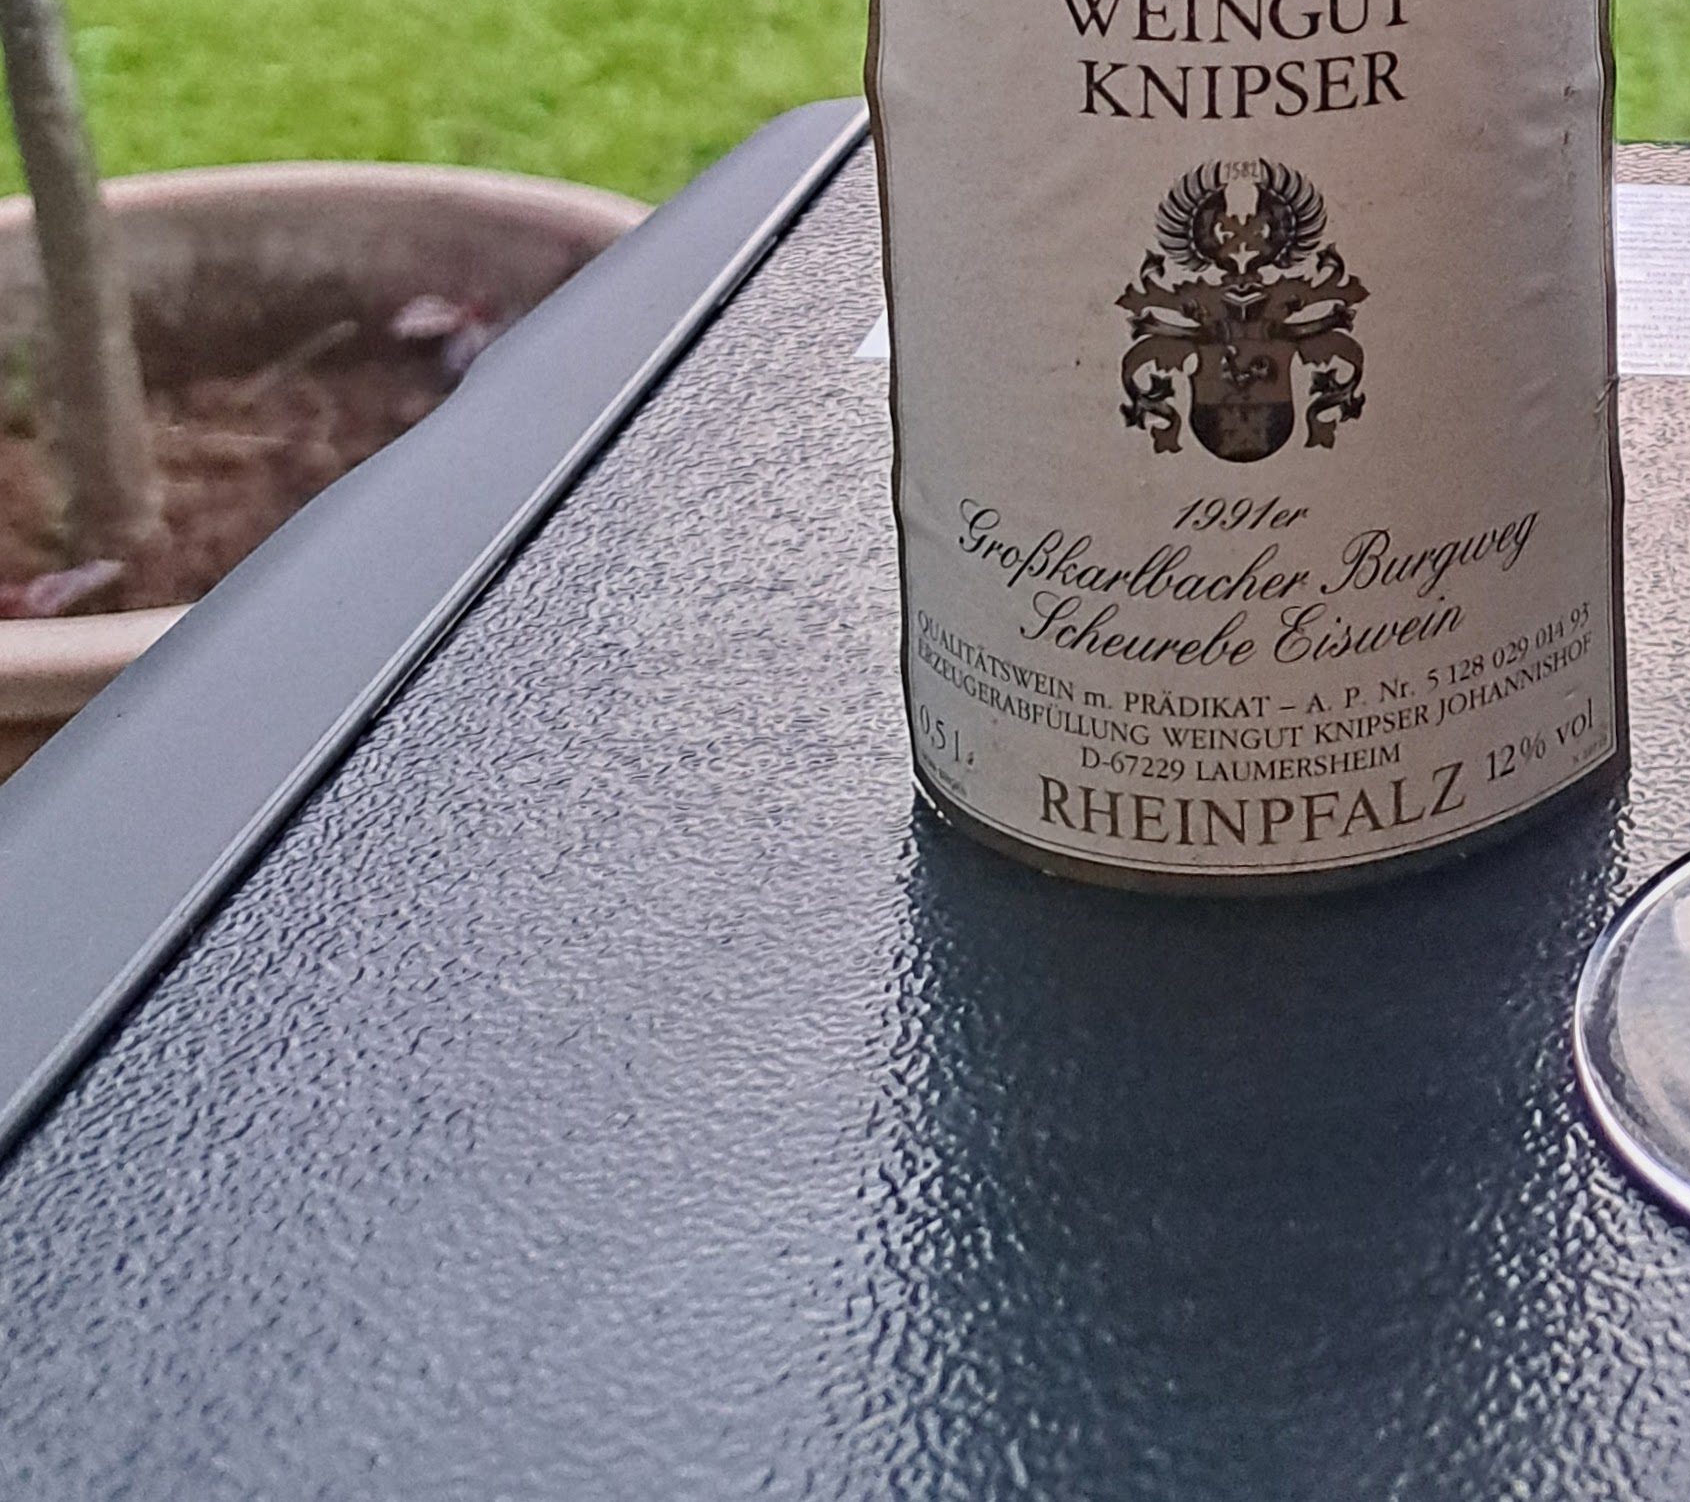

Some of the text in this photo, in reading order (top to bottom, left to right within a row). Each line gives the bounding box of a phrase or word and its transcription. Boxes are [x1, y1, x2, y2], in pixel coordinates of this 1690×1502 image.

[1078, 50, 1408, 120] KNIPSER
[958, 497, 1540, 602] Großkarlbacher Burgweg
[1173, 495, 1310, 531] 1991er
[917, 609, 1075, 702] QUALITÄTSWEIN
[1084, 690, 1112, 710] m.
[1124, 690, 1271, 718] PRÄDIKAT
[1306, 692, 1332, 714] A.
[1344, 686, 1367, 709] P.
[1379, 678, 1415, 703] Nr.
[1427, 668, 1440, 692] 5
[1448, 654, 1485, 686] 128
[1492, 636, 1530, 669] 029
[1534, 620, 1564, 646] 014
[1570, 601, 1591, 633] 93
[1019, 590, 1465, 666] Scheurebe Eiswein
[918, 630, 1593, 750] ERZEUGERABFÜLLUNG WEINGUT KNIPSER JOHANNISHOF
[1555, 697, 1594, 745] vol
[1081, 742, 1401, 782] D-67229 LAUMERSHEIM
[1039, 761, 1467, 847] RHEINPFALZ
